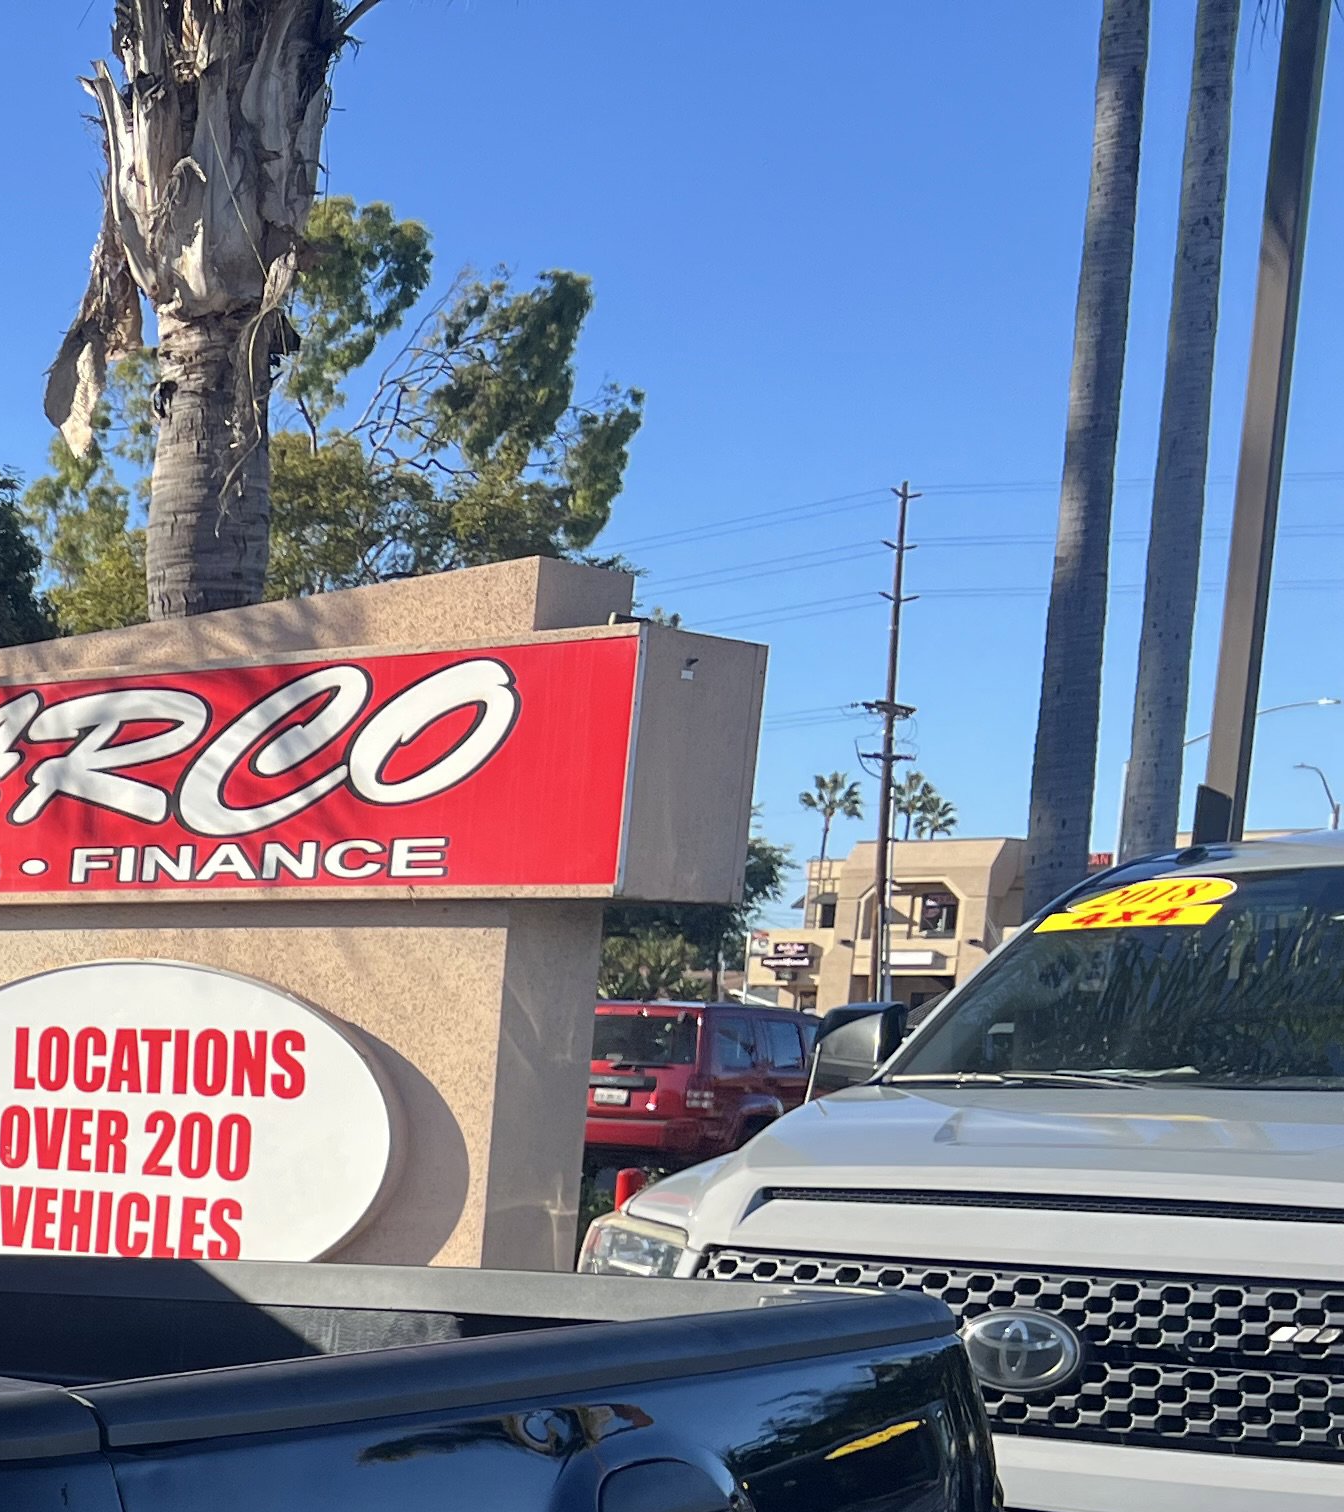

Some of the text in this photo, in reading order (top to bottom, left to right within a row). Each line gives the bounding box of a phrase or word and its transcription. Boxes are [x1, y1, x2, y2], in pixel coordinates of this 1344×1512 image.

[68, 835, 450, 884] FINANCE
[1089, 881, 1212, 910] 2018
[13, 1026, 306, 1099] LOCATIONS
[141, 1110, 252, 1181] 200
[0, 1185, 243, 1260] VEHICLES
